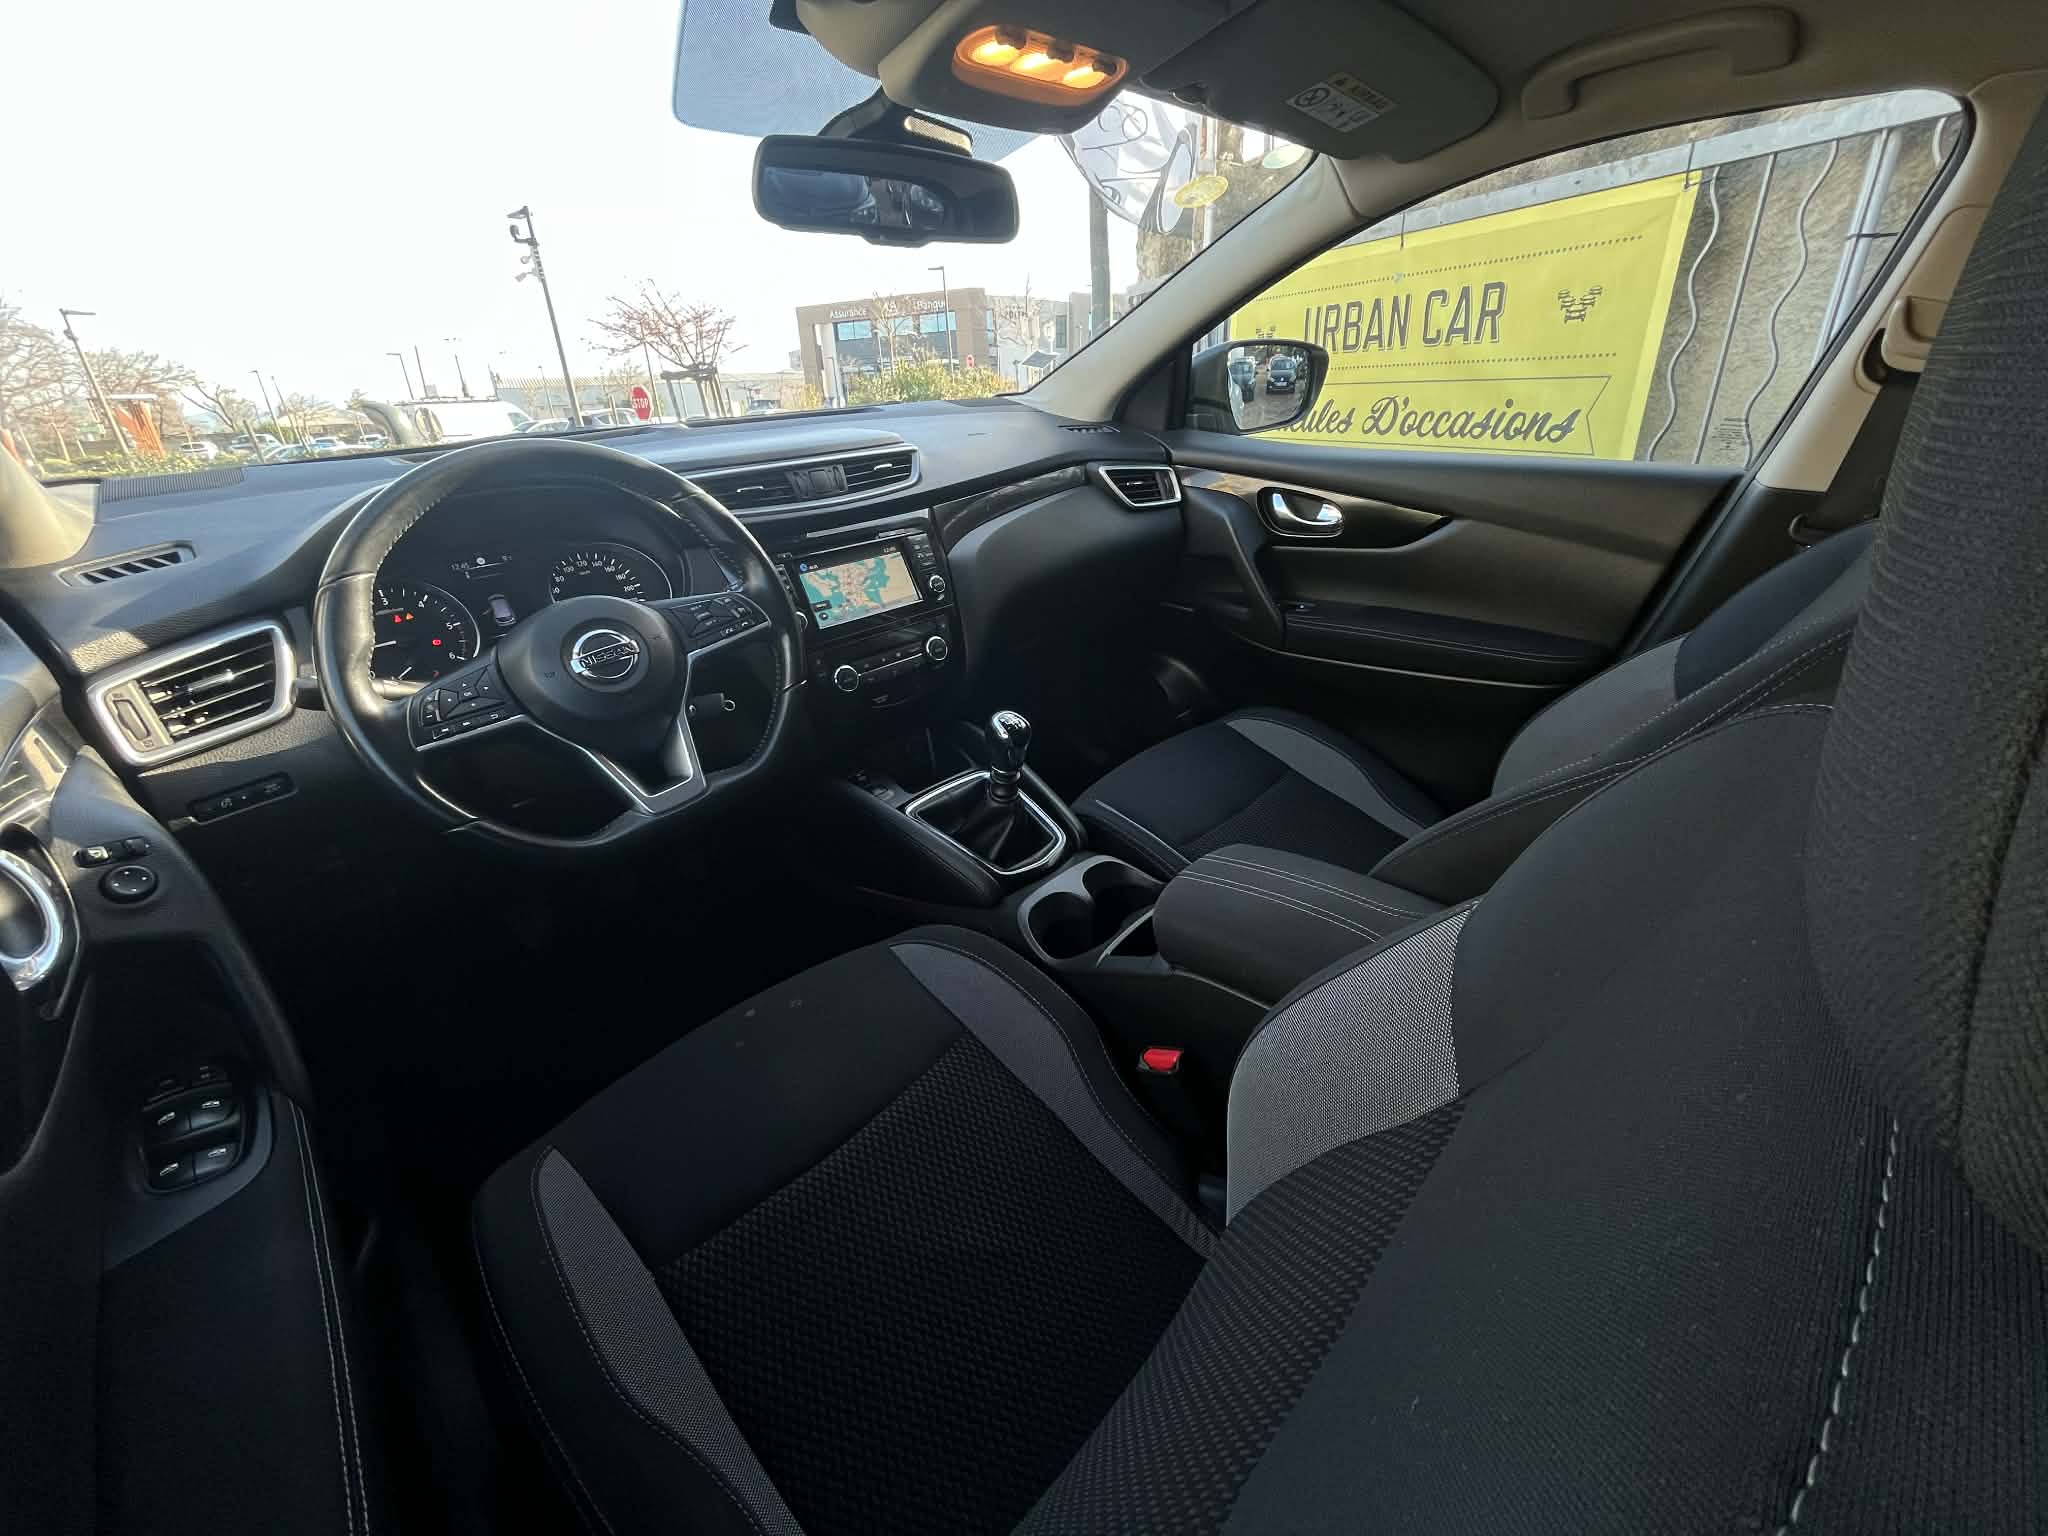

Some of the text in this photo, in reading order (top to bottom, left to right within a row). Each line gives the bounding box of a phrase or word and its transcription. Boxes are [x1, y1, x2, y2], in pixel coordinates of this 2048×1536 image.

[1304, 281, 1508, 353] URBAN CAR
[632, 397, 649, 409] STOP
[1362, 395, 1582, 443] D'occasions
[563, 565, 574, 573] 100
[624, 584, 635, 592] 200
[381, 597, 388, 606] 3
[418, 600, 425, 608] 4
[446, 622, 453, 630] 5
[449, 652, 456, 660] 6
[581, 646, 635, 667] NISSAN
